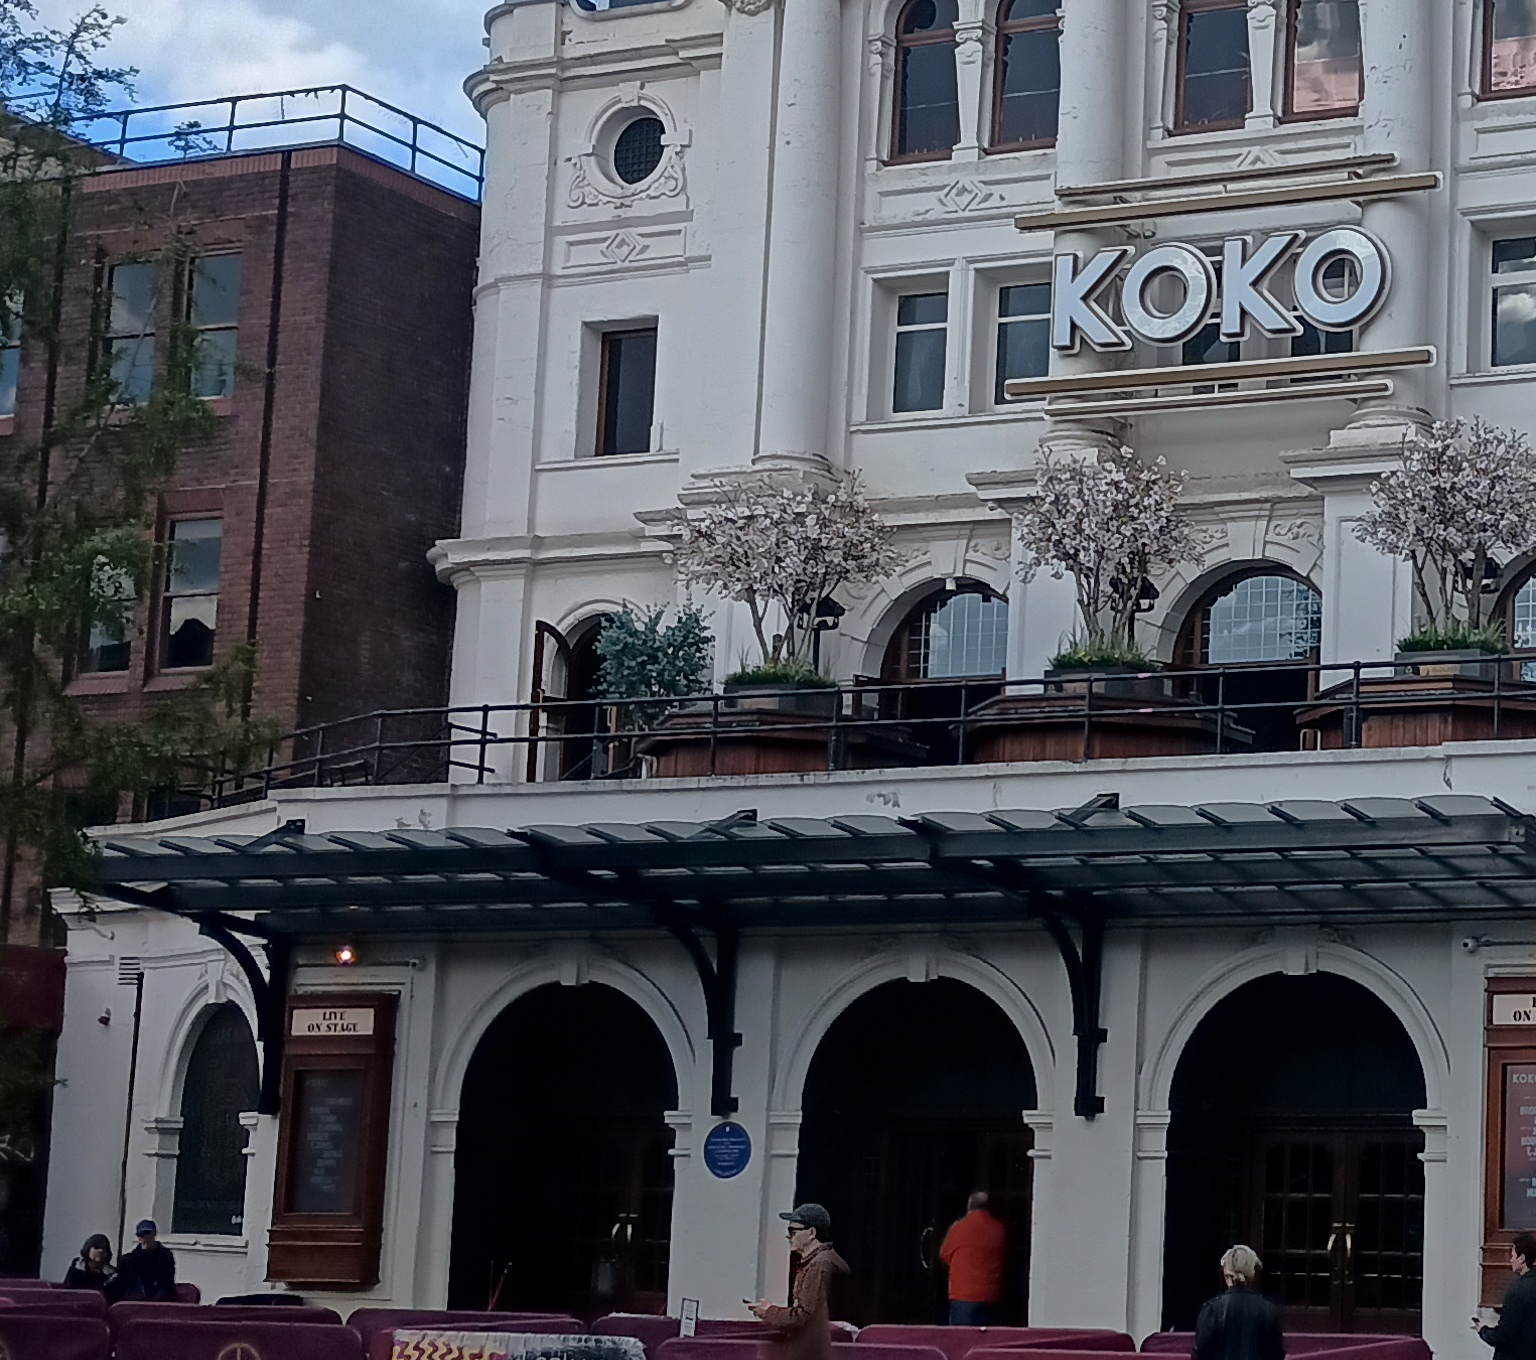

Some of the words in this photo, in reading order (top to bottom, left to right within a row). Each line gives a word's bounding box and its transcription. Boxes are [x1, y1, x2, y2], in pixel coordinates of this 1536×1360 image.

[1052, 225, 1391, 351] KOKO
[322, 1011, 347, 1021] LIVE
[1512, 1010, 1532, 1021] ON
[307, 1022, 322, 1033] ON
[325, 1022, 360, 1033] STAGE
